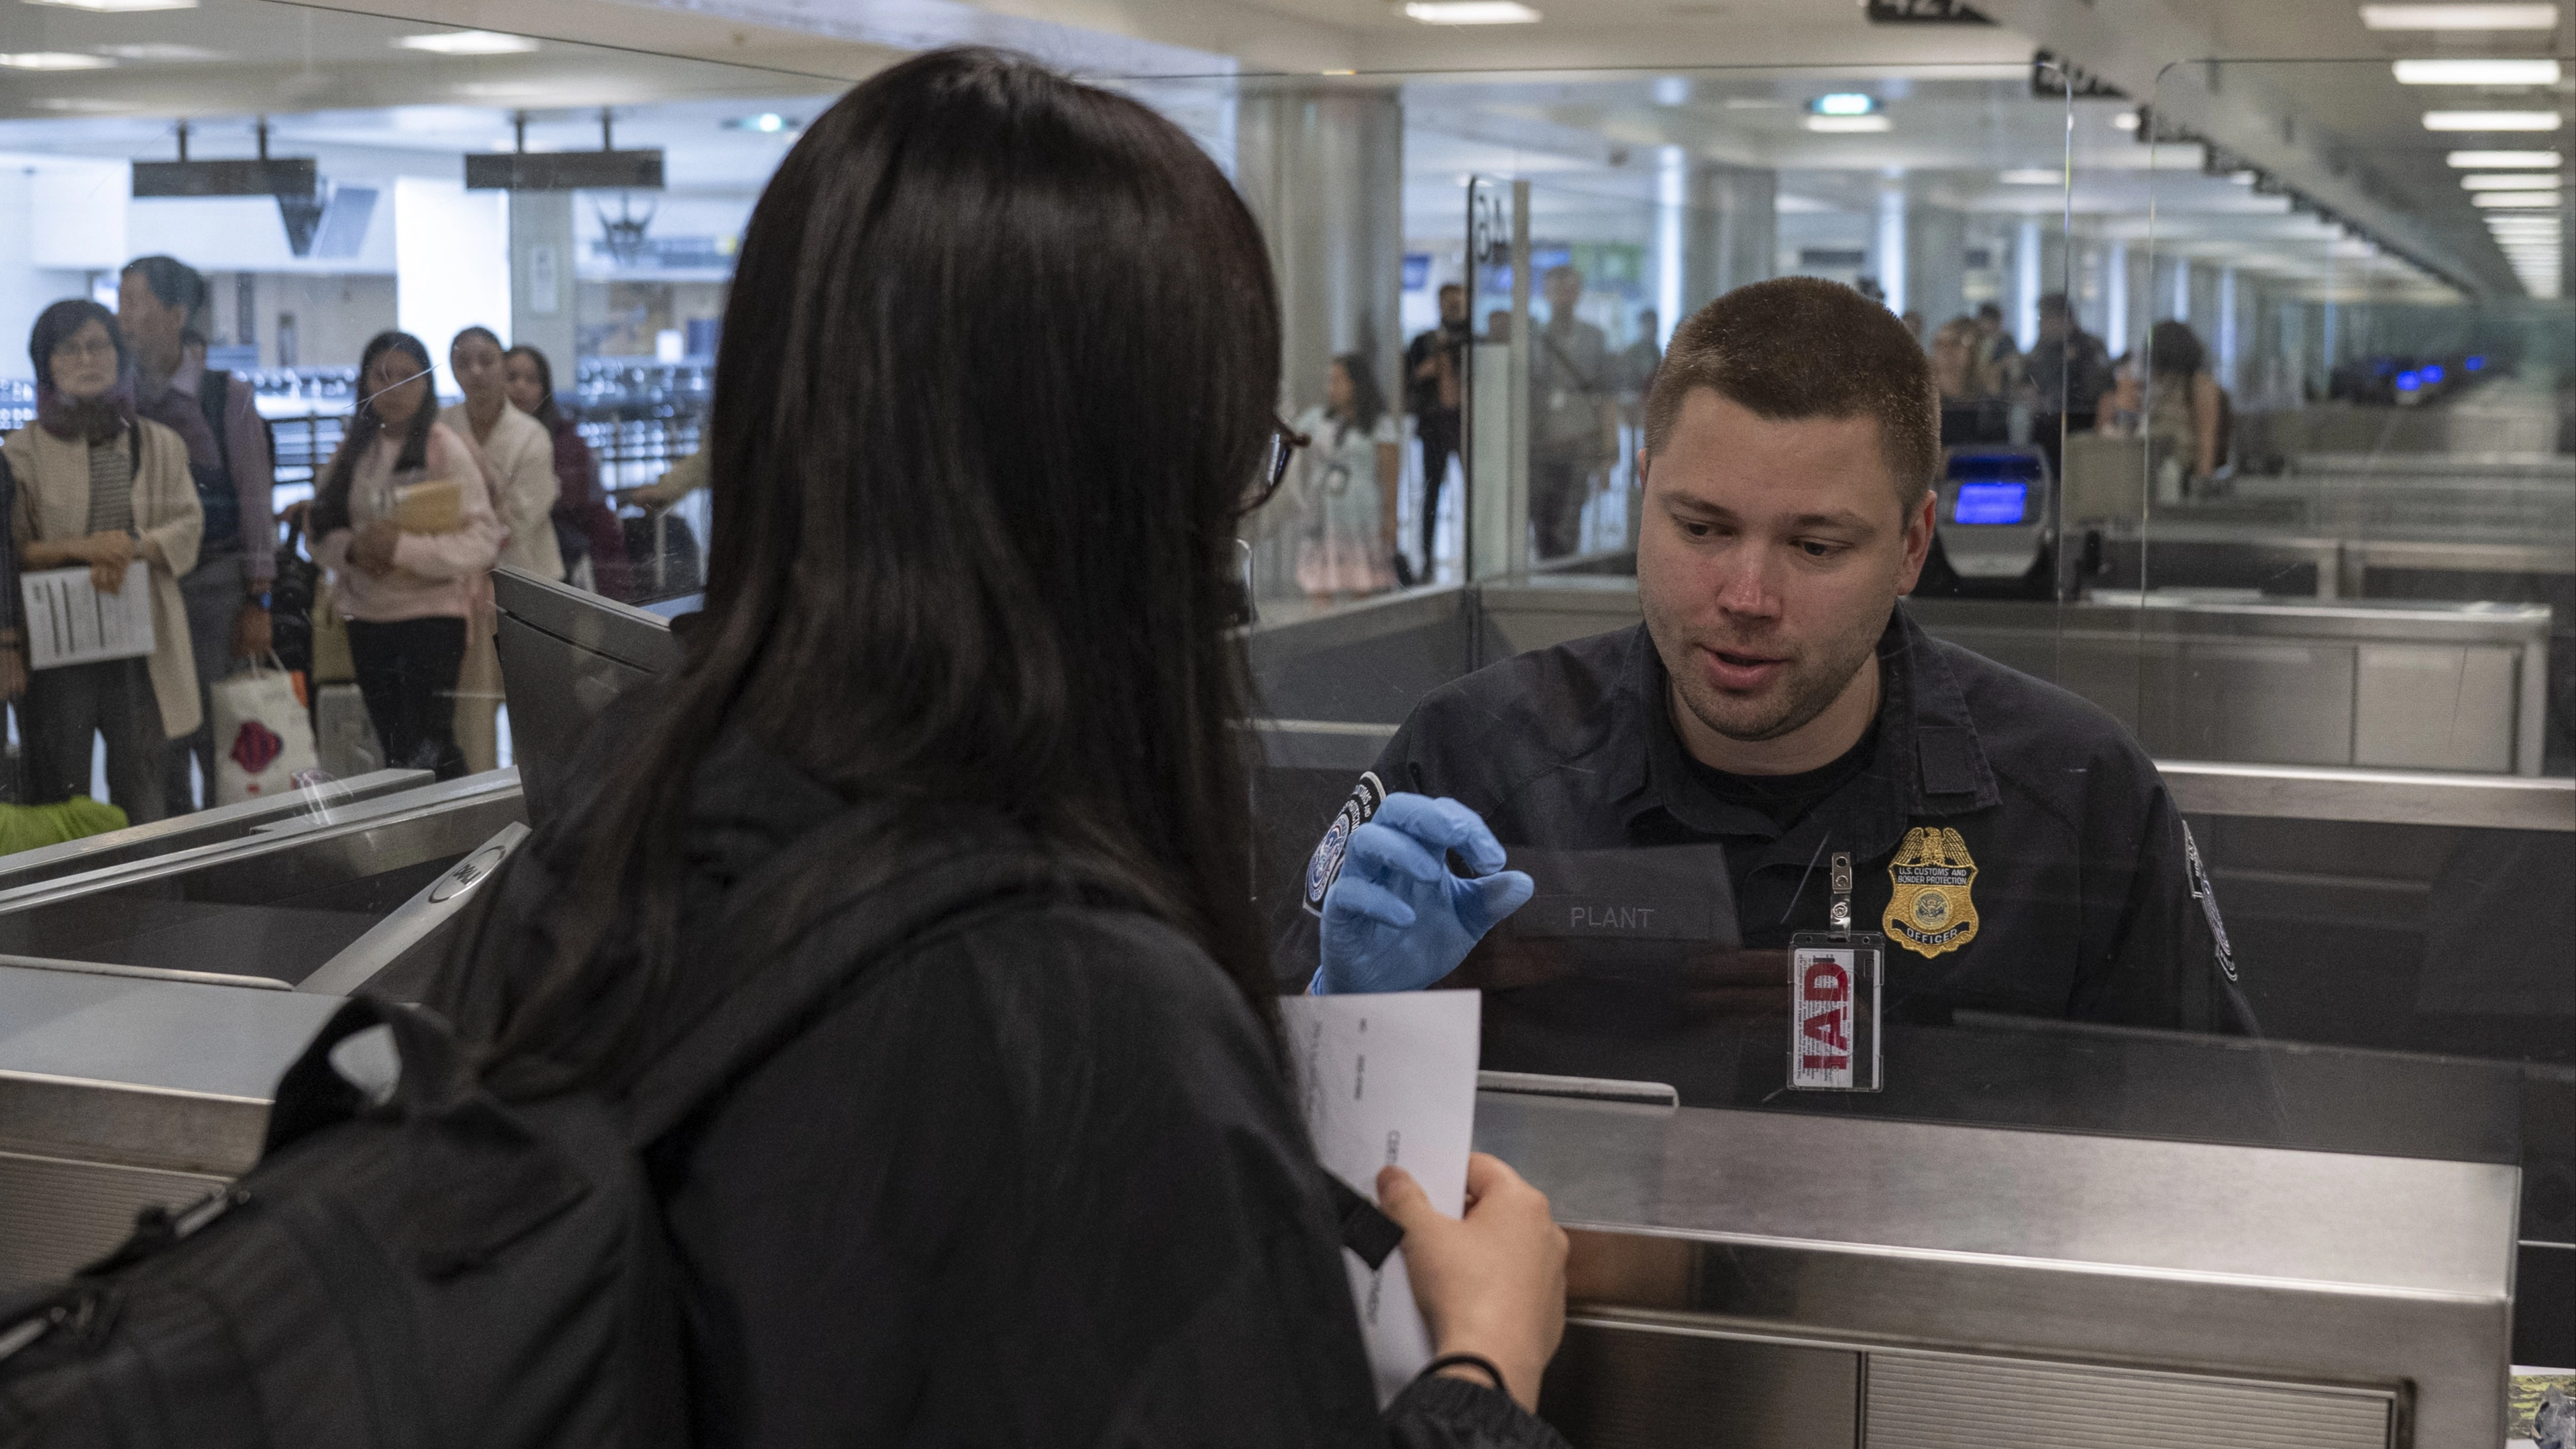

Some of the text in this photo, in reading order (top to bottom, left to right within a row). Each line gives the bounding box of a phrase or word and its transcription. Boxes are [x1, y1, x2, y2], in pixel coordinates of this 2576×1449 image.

[1898, 875, 1967, 885] BORDER PROTECTION
[1914, 867, 1949, 876] CUSTOMS
[1571, 906, 1655, 928] PLANT
[1907, 927, 1957, 944] OFFICER
[1803, 963, 1847, 1069] IAD
